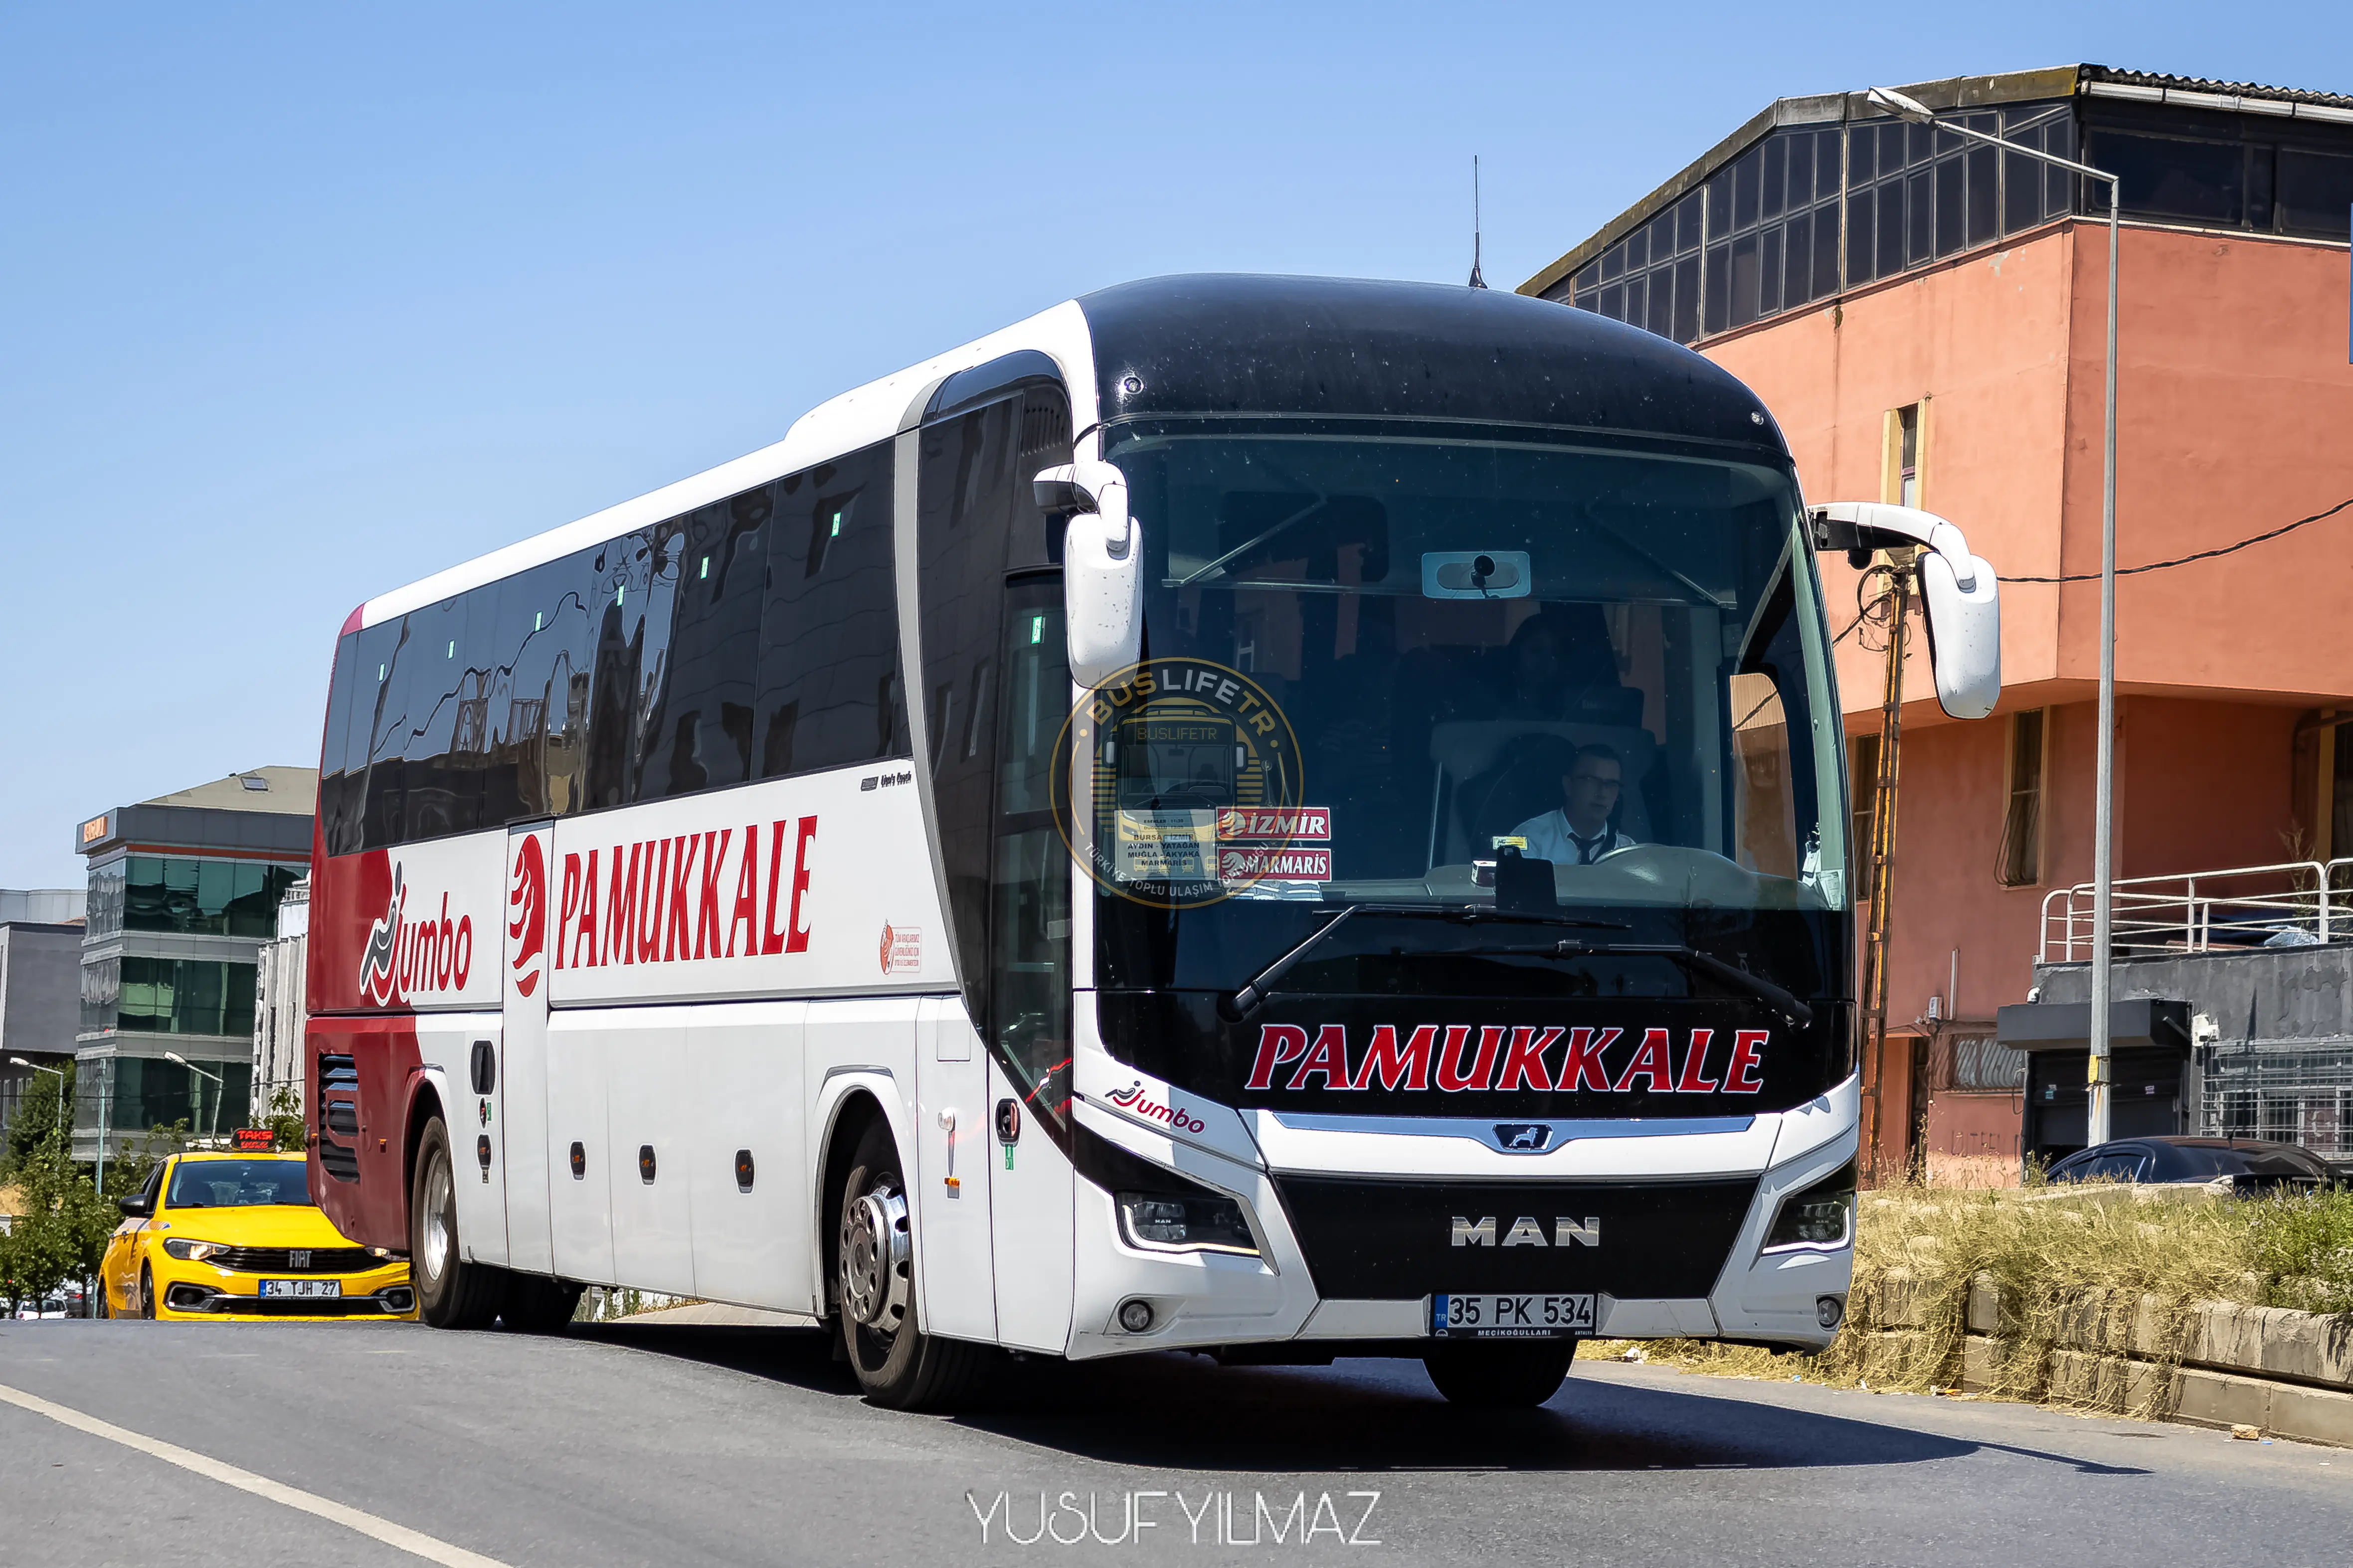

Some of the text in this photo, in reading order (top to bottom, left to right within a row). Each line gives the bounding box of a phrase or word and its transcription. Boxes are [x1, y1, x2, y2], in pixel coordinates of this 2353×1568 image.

[1247, 812, 1325, 835] İZMİR
[1247, 854, 1327, 874] MARMARİS
[554, 815, 818, 970] PAMUKKALE
[1245, 1024, 1770, 1093] PAMUKKALE
[1451, 1217, 1600, 1246] MAN
[289, 1250, 312, 1268] FIAT
[267, 1281, 282, 1295] 34
[291, 1281, 313, 1295] TJH
[321, 1282, 337, 1295] 27
[1449, 1297, 1591, 1325] 35 PK 534
